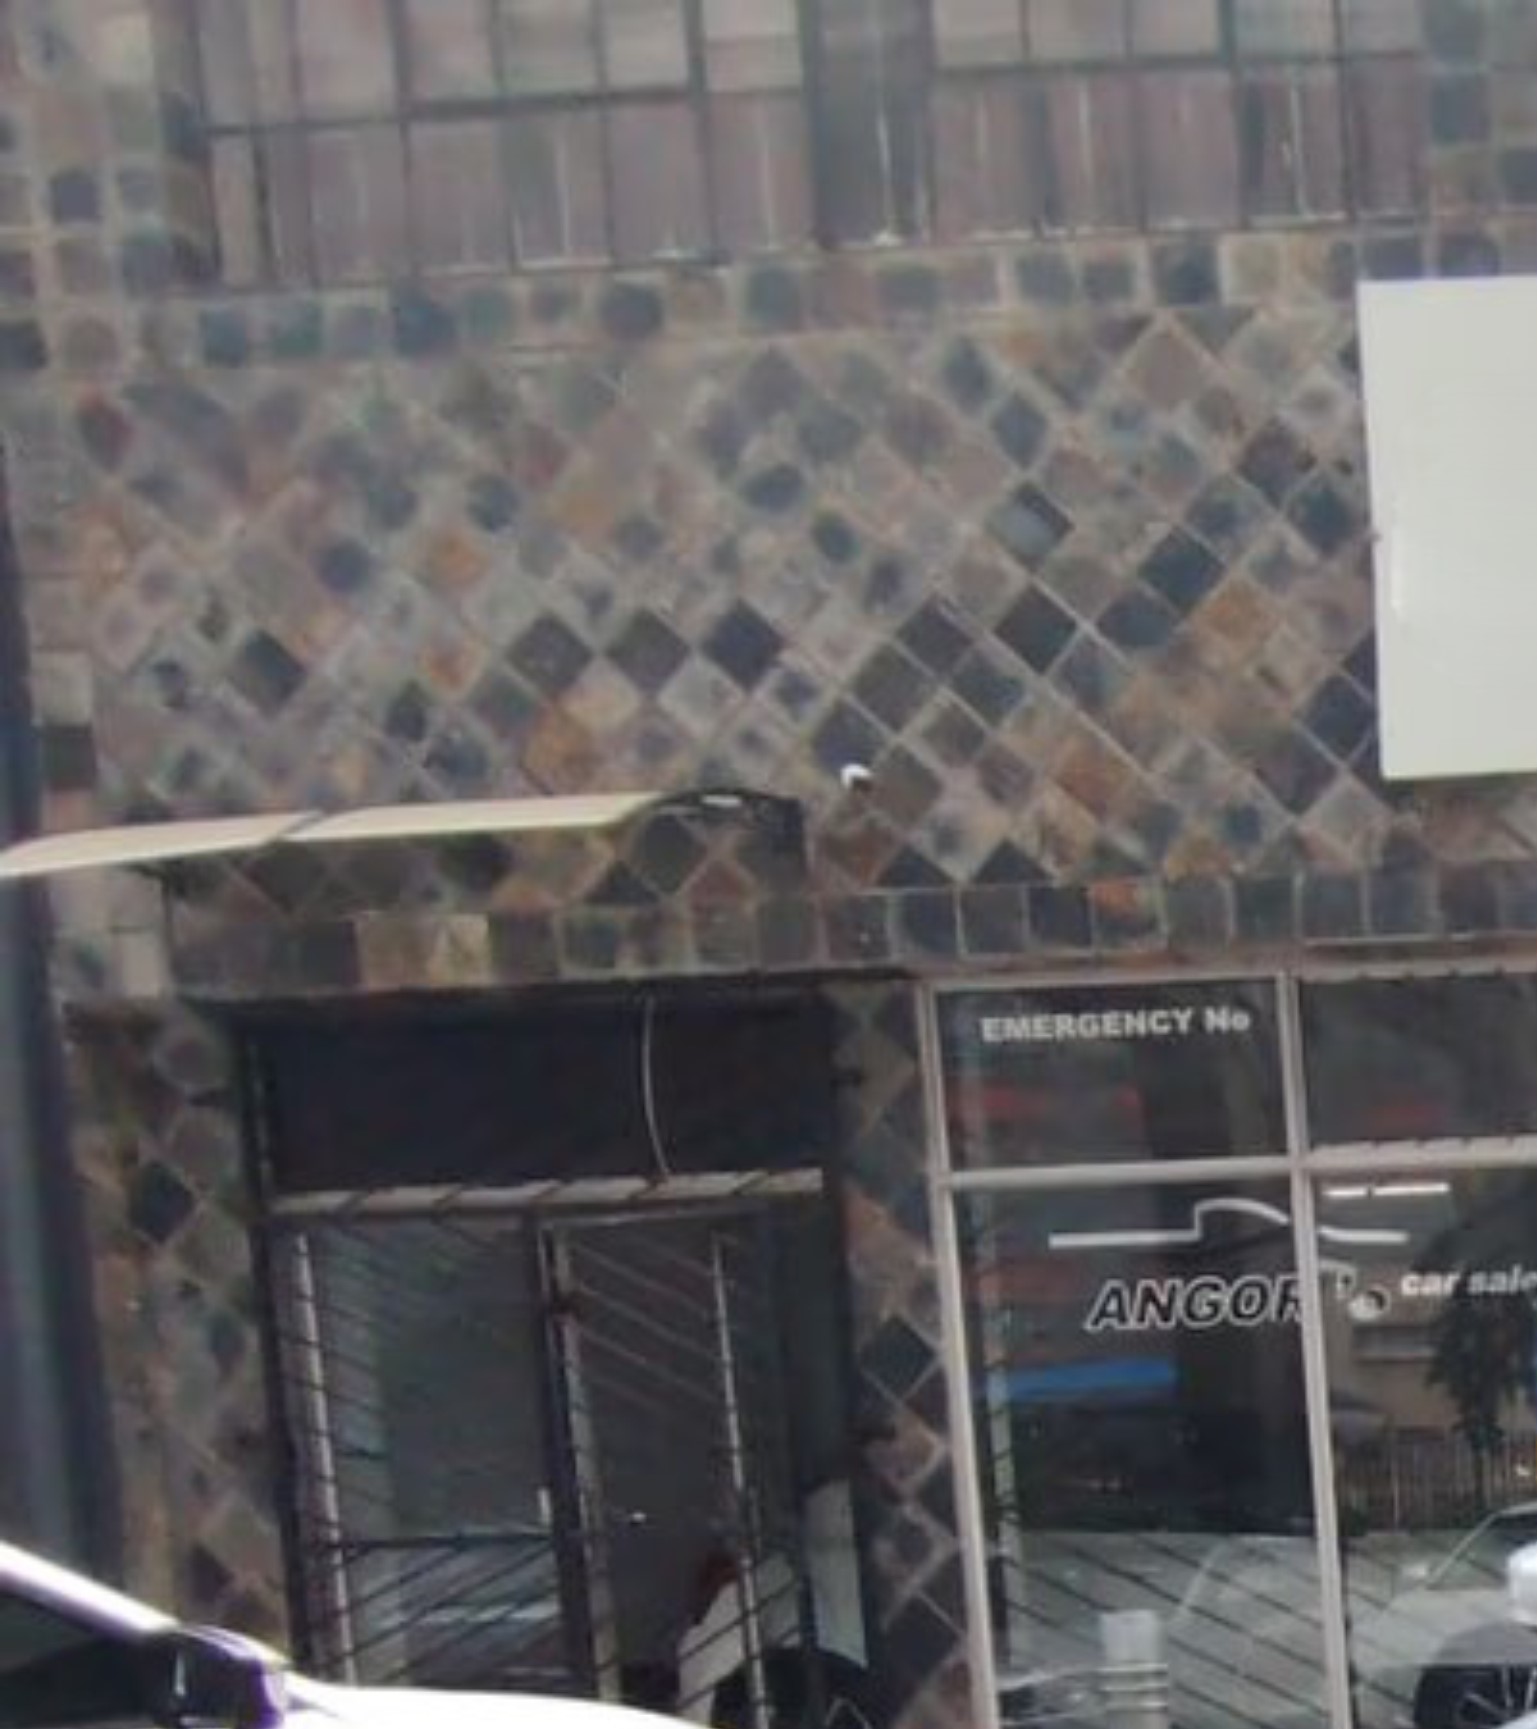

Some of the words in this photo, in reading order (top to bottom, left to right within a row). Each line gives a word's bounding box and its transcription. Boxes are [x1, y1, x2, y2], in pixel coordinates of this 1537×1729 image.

[980, 1007, 1195, 1043] EMERGENCY
[1204, 1005, 1251, 1034] No
[1400, 1269, 1461, 1297] car
